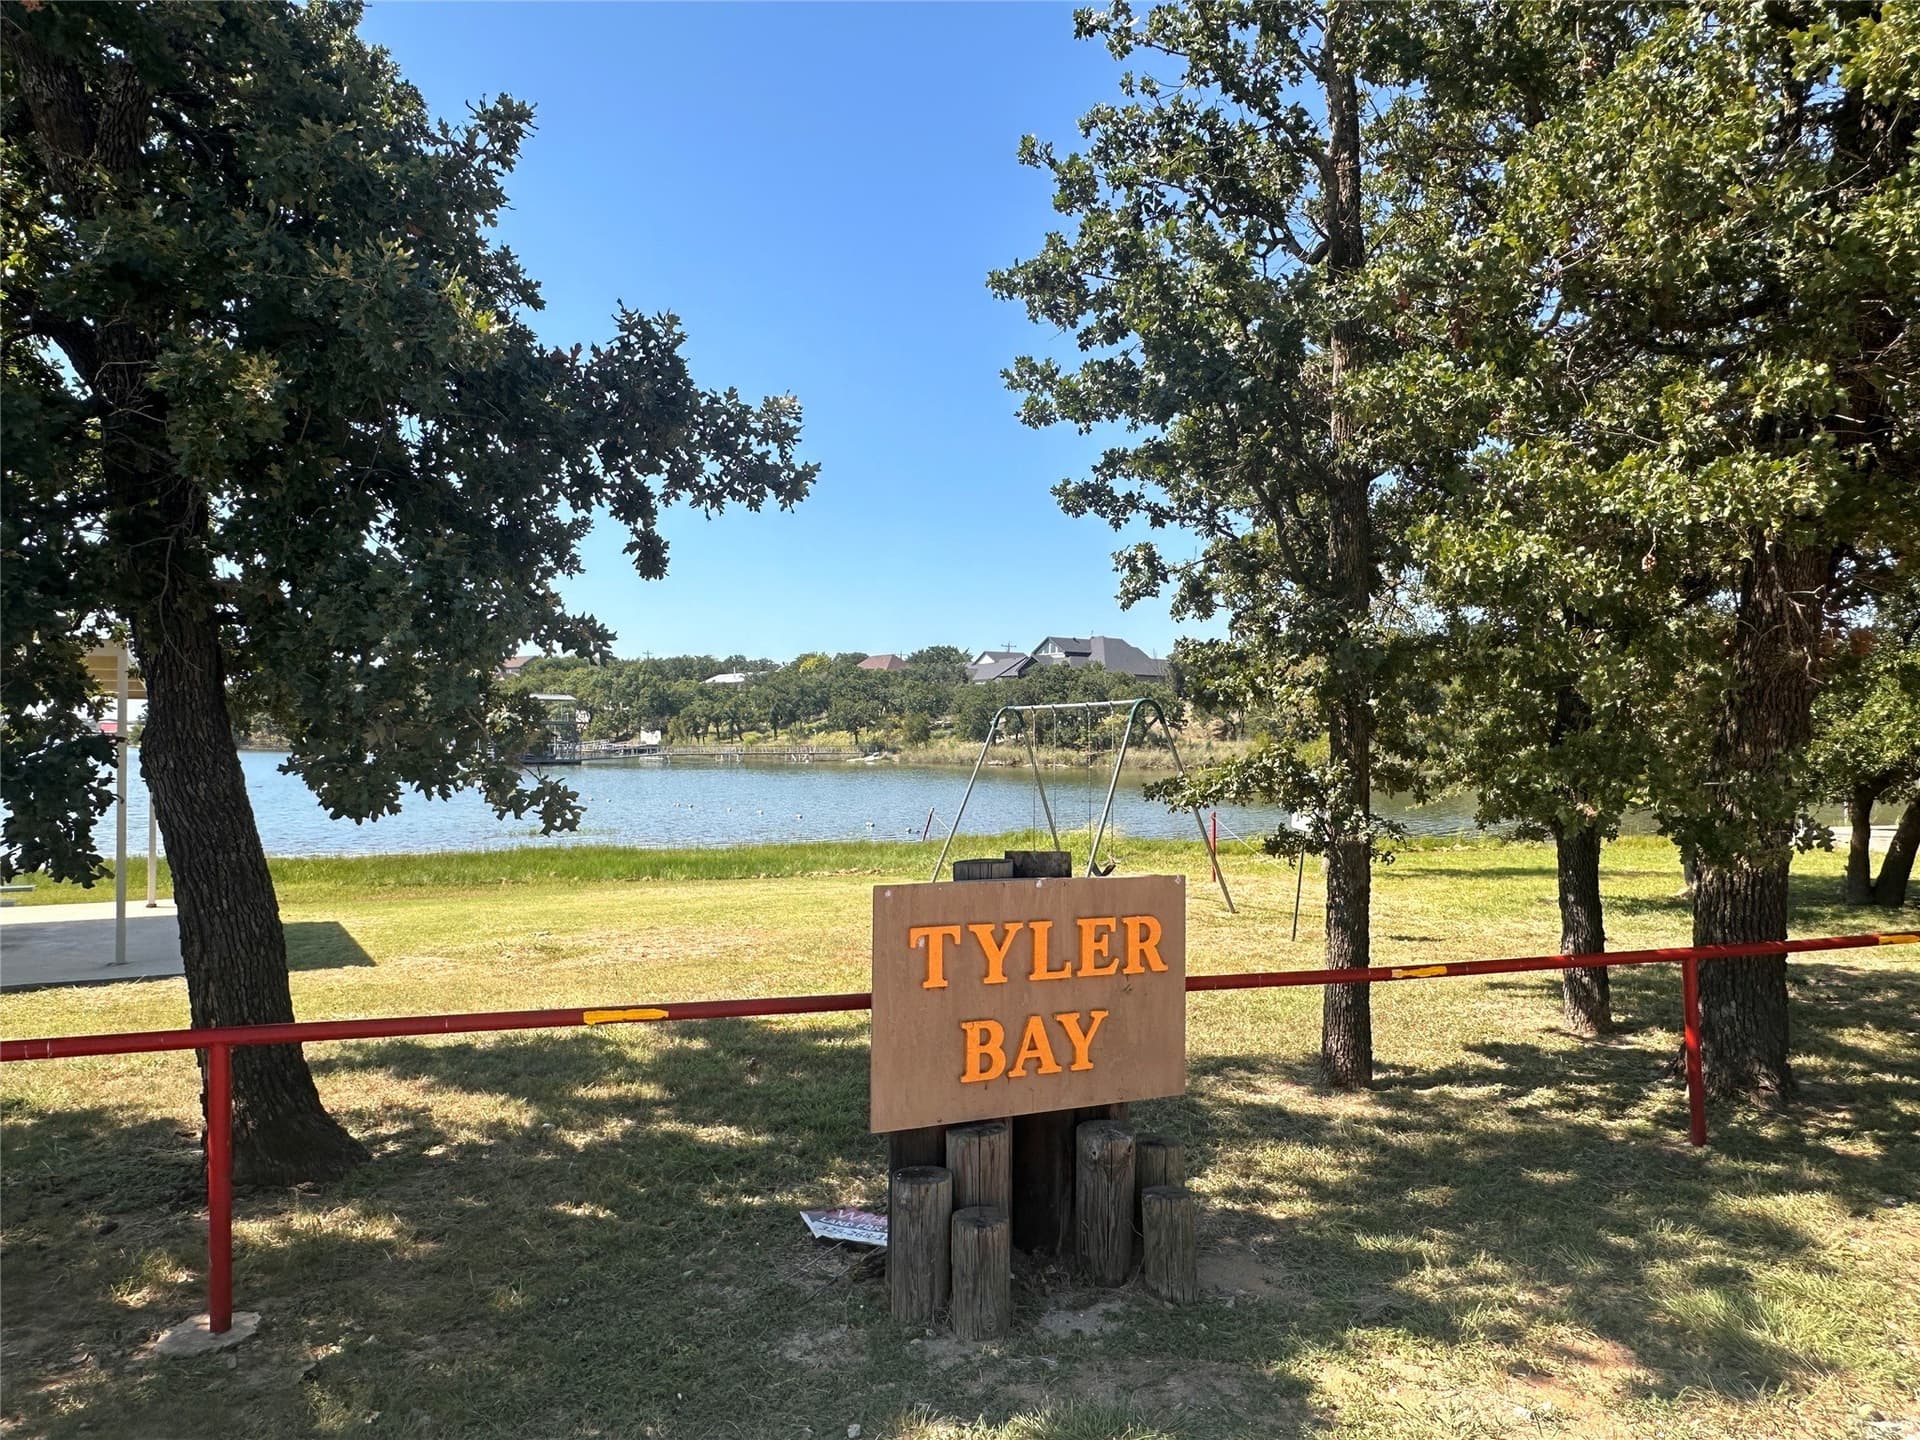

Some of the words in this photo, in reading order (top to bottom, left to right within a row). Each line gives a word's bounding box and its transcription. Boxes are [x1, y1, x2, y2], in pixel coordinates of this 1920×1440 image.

[909, 915, 1169, 990] TYLER
[960, 1009, 1109, 1084] BAY
[819, 1216, 854, 1227] LAND
[856, 1223, 883, 1232] FOR
